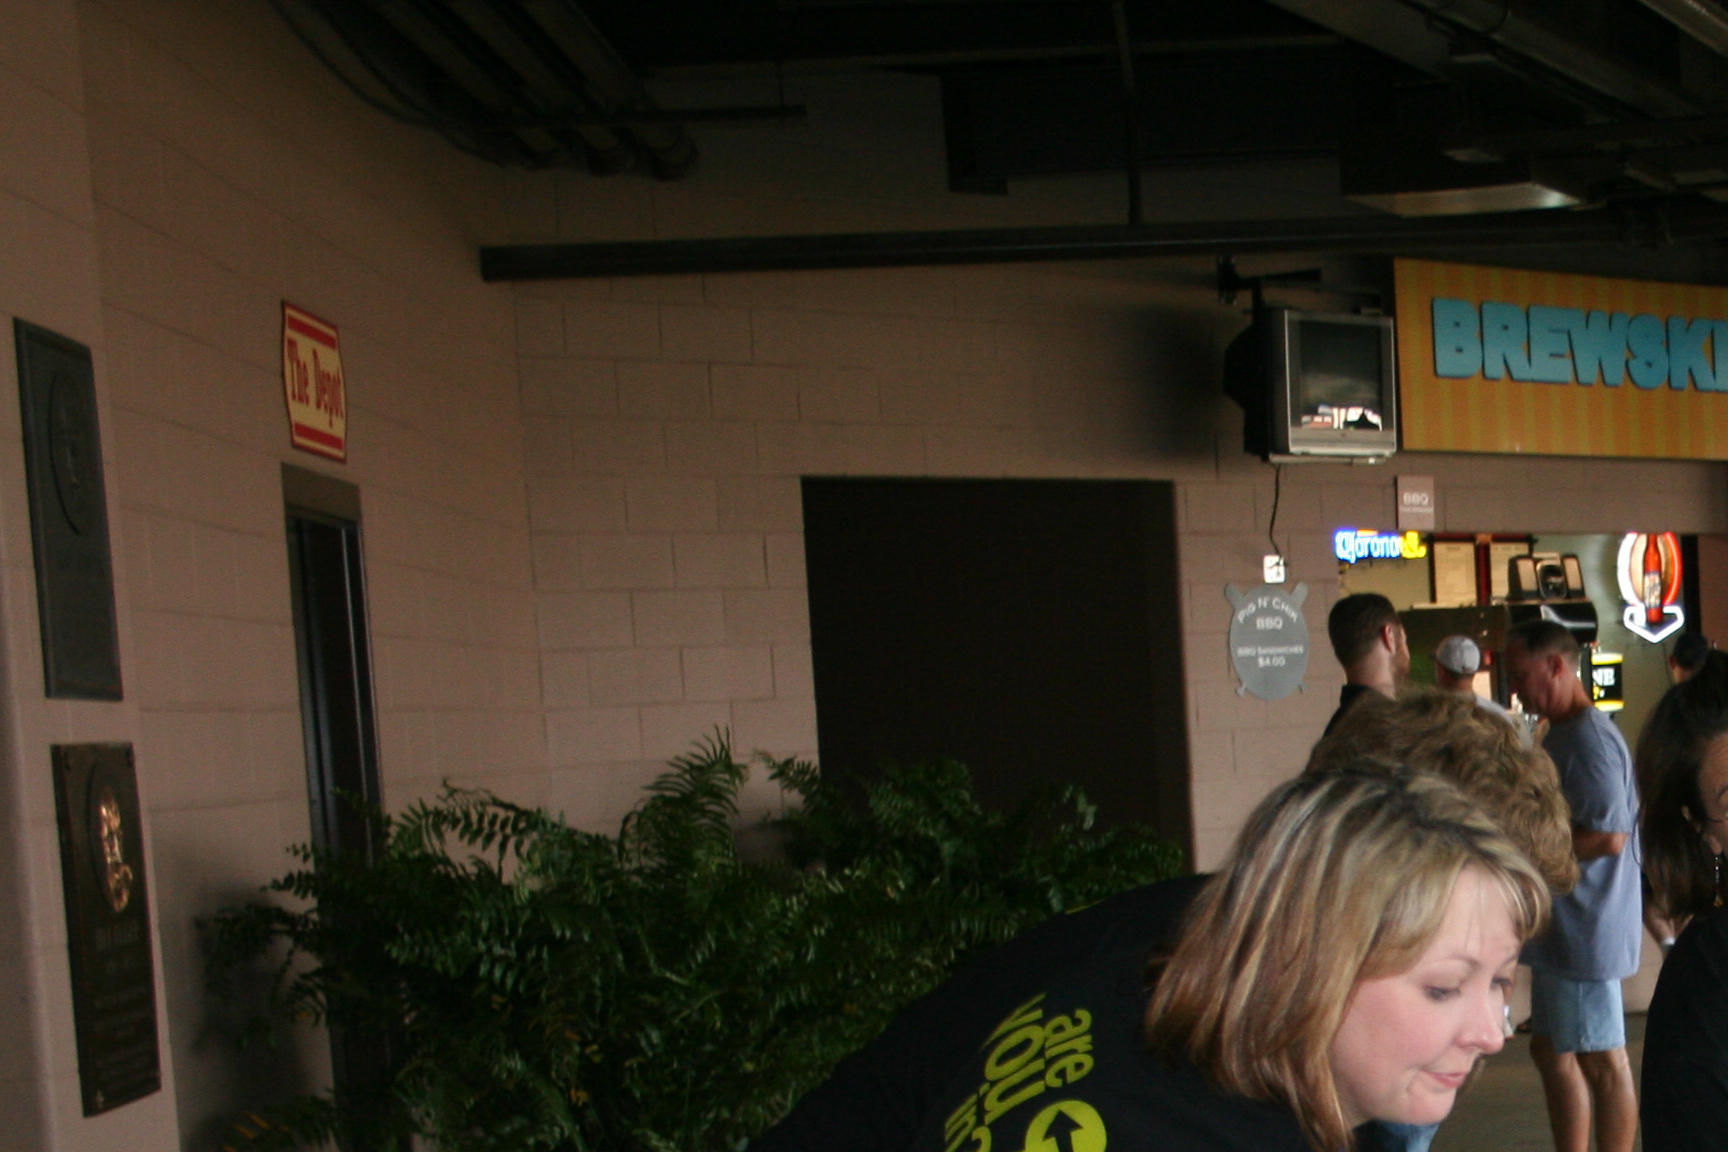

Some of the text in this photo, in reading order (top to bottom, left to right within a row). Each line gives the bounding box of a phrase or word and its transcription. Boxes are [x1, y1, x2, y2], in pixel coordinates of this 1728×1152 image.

[287, 336, 345, 429] The Depot
[1402, 492, 1430, 507] BBQ
[1255, 617, 1284, 630] BBQ
[979, 993, 1046, 1126] you
[1045, 1007, 1095, 1088] are
